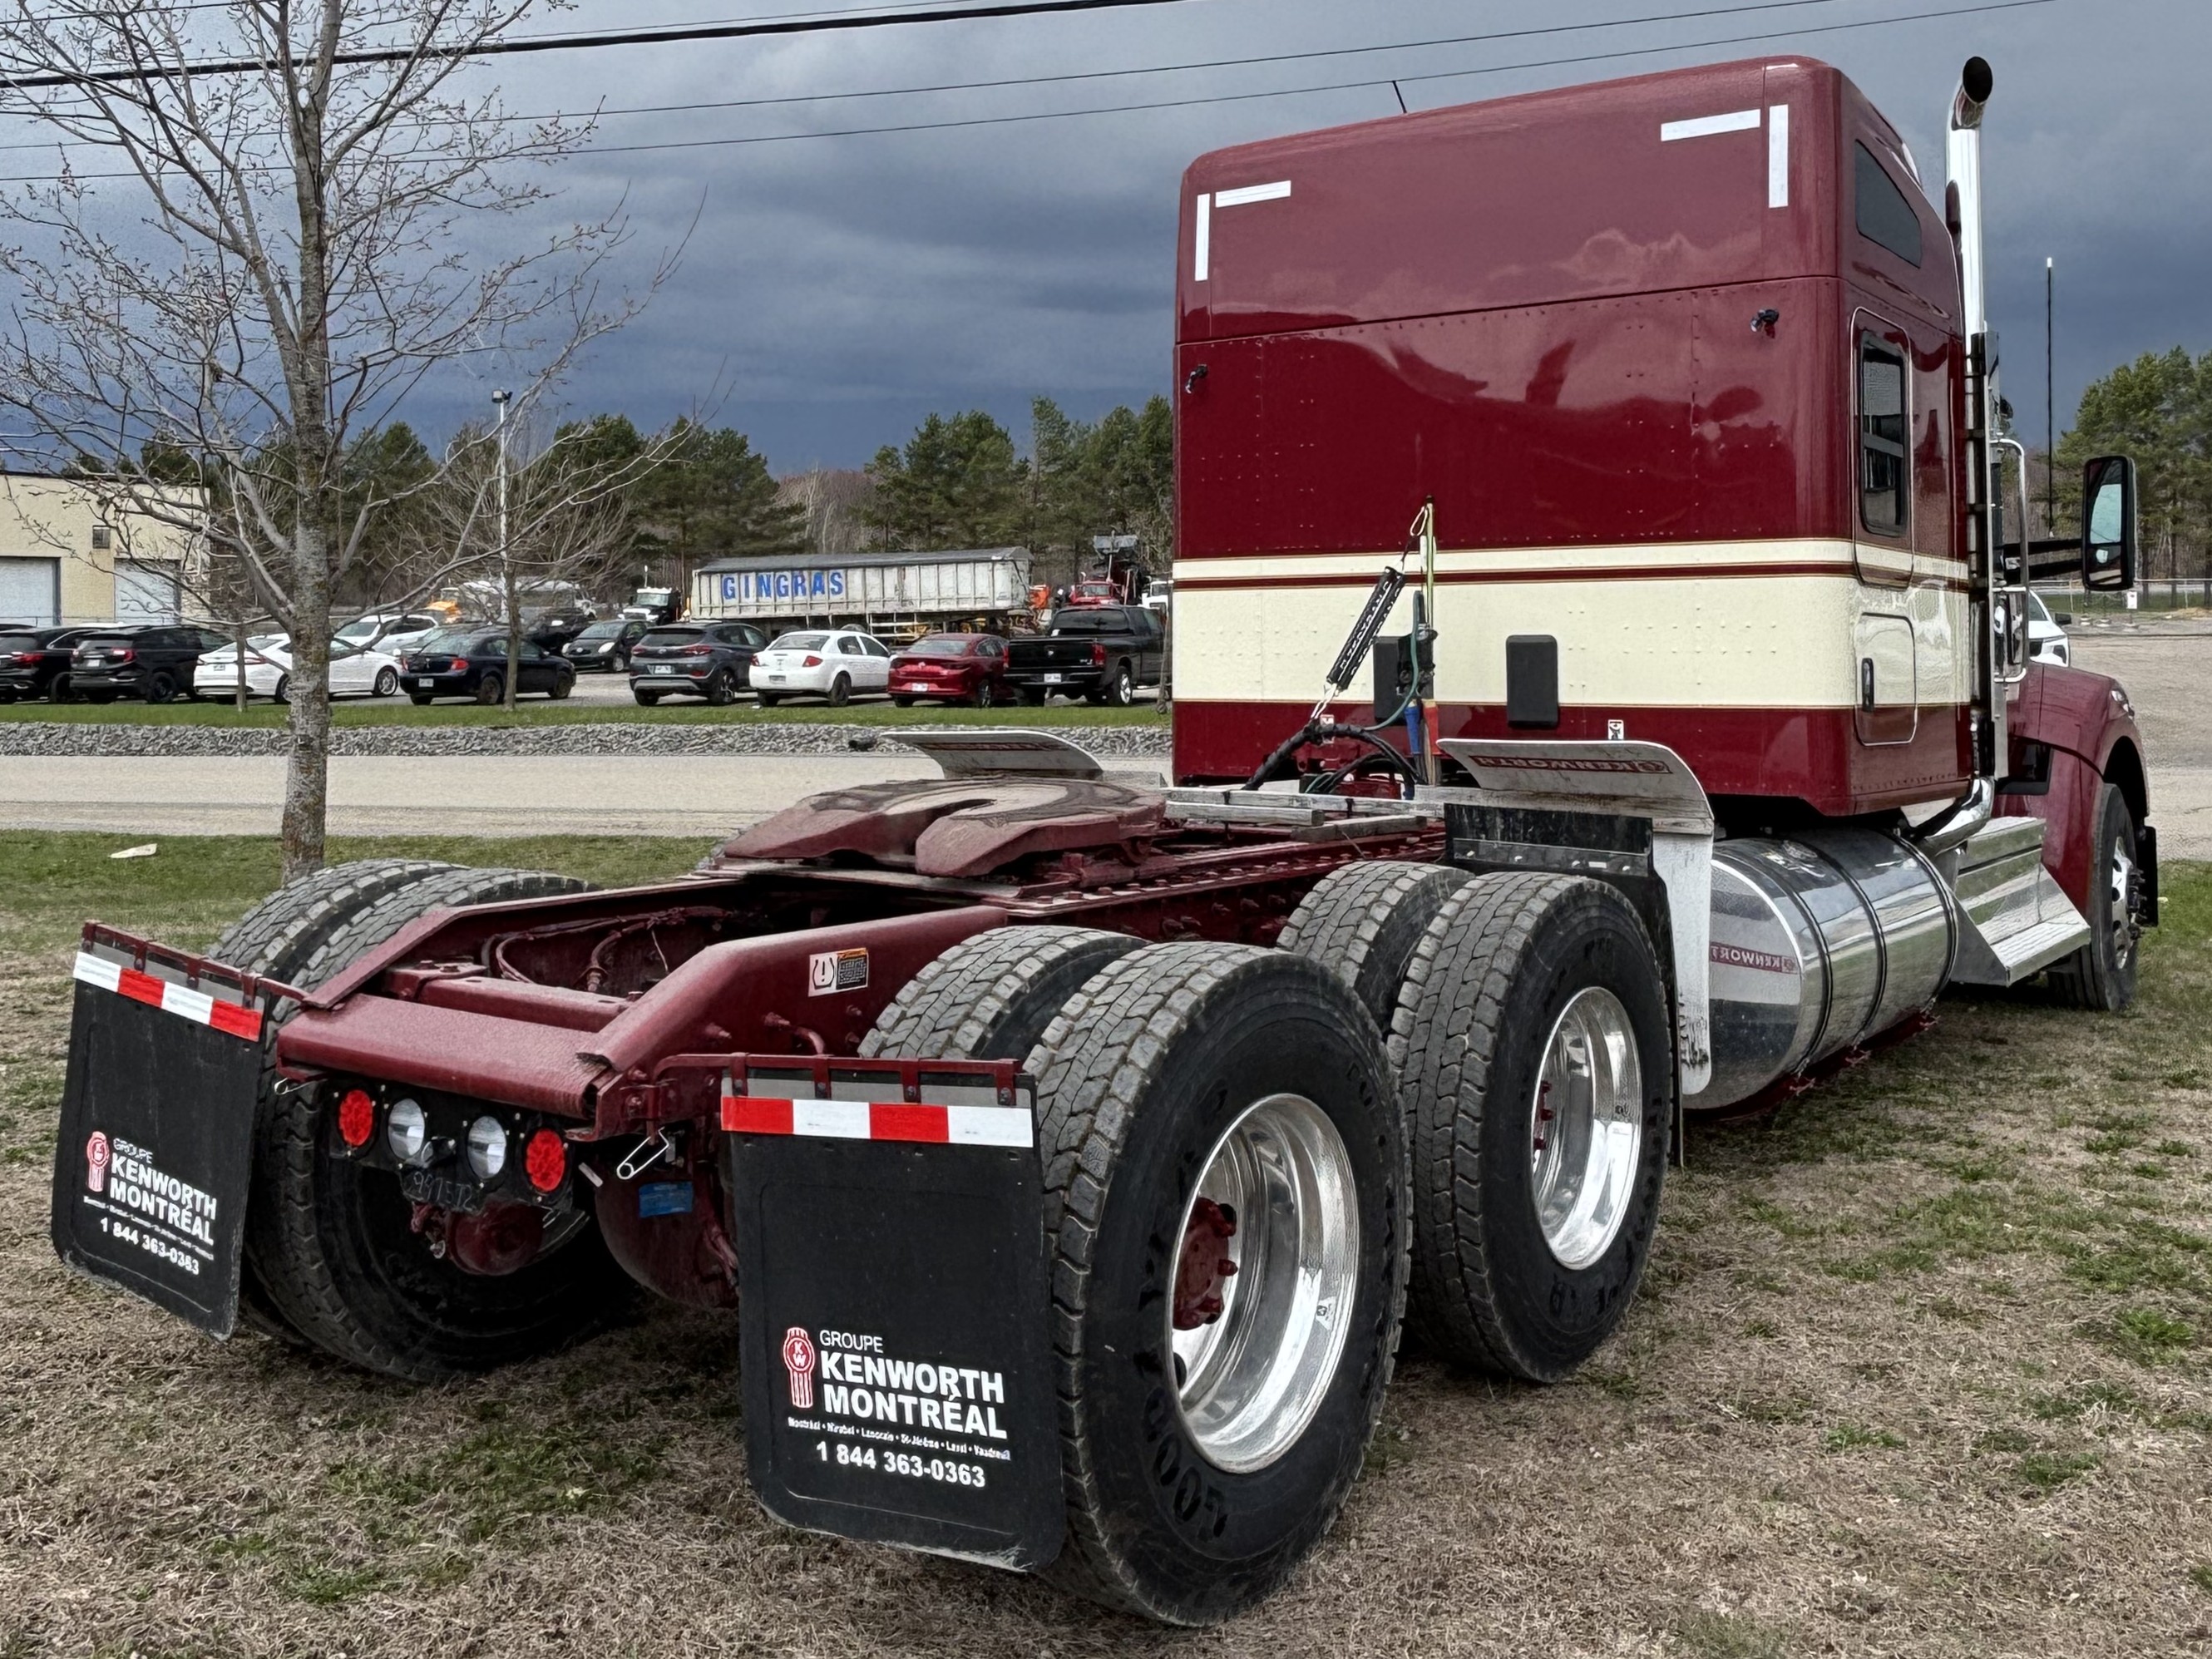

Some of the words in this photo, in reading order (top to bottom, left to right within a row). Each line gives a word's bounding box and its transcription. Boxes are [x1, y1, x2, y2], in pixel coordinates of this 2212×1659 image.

[723, 572, 844, 600] GINGRAS
[110, 1176, 215, 1246] MONTRÉAL
[111, 1152, 217, 1220] KENWORTH
[100, 1217, 108, 1232] 1
[113, 1222, 139, 1245] 844
[819, 1330, 883, 1353] GROUPE
[820, 1350, 1005, 1404] KENWORTH
[823, 1384, 1008, 1439] MONTRÉAL
[816, 1441, 827, 1461] 1
[837, 1444, 876, 1469] 844
[883, 1451, 986, 1487] 363-0363
